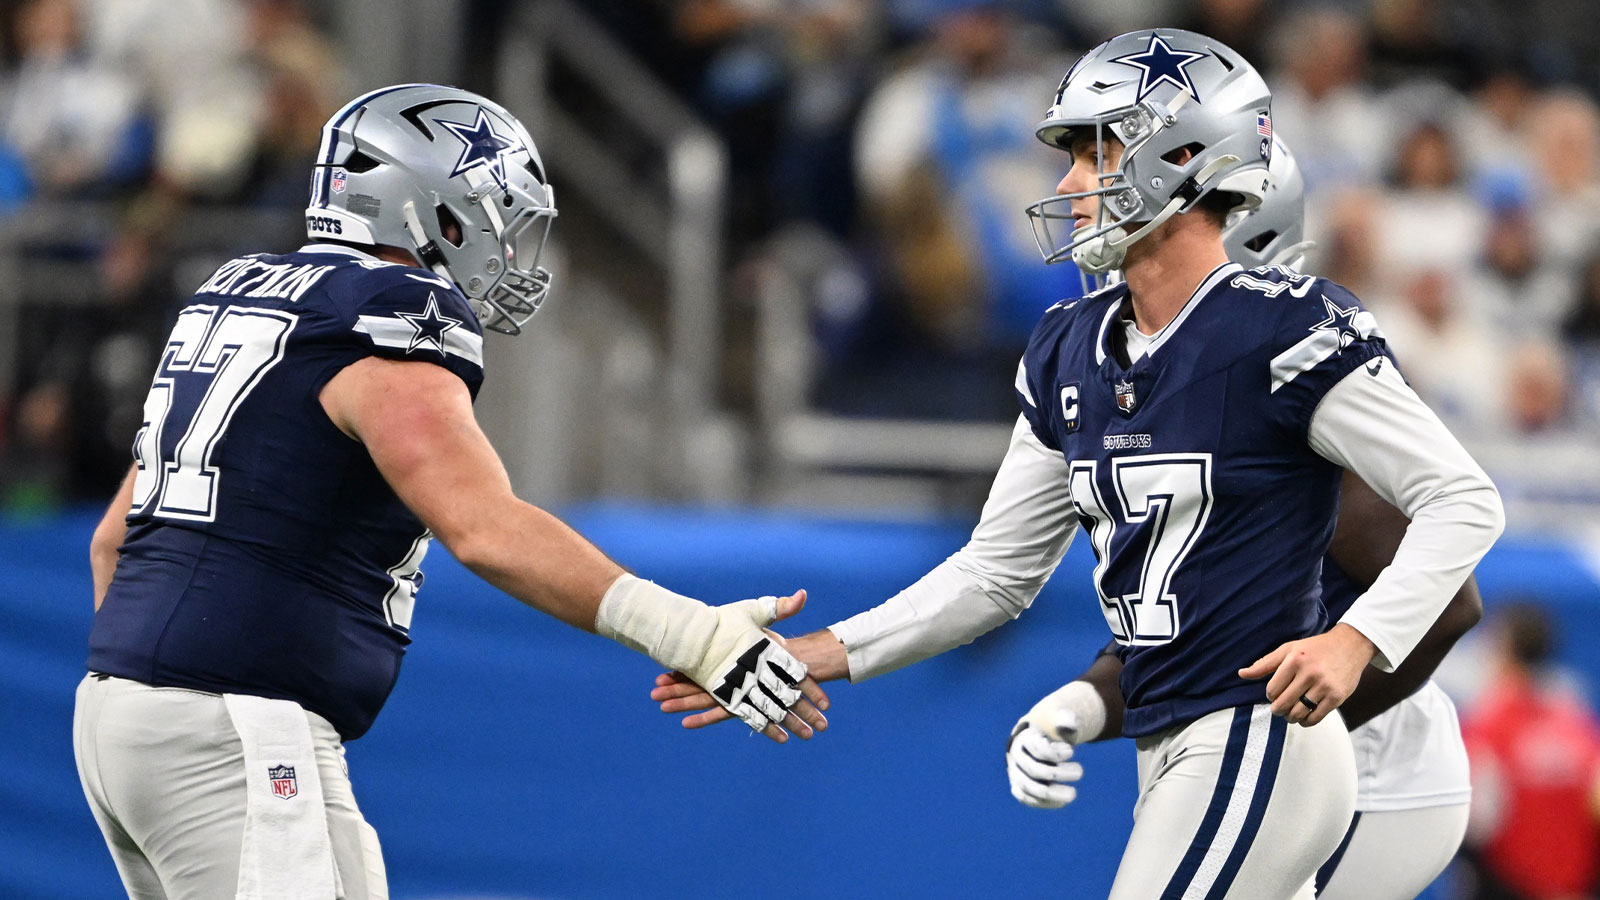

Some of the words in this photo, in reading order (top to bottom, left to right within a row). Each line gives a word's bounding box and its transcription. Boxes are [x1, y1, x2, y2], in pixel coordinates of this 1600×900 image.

[1061, 386, 1078, 420] C
[1118, 394, 1135, 408] NFL
[1103, 434, 1152, 450] COWBOYS
[1069, 453, 1214, 647] 17
[273, 779, 296, 797] NFL
